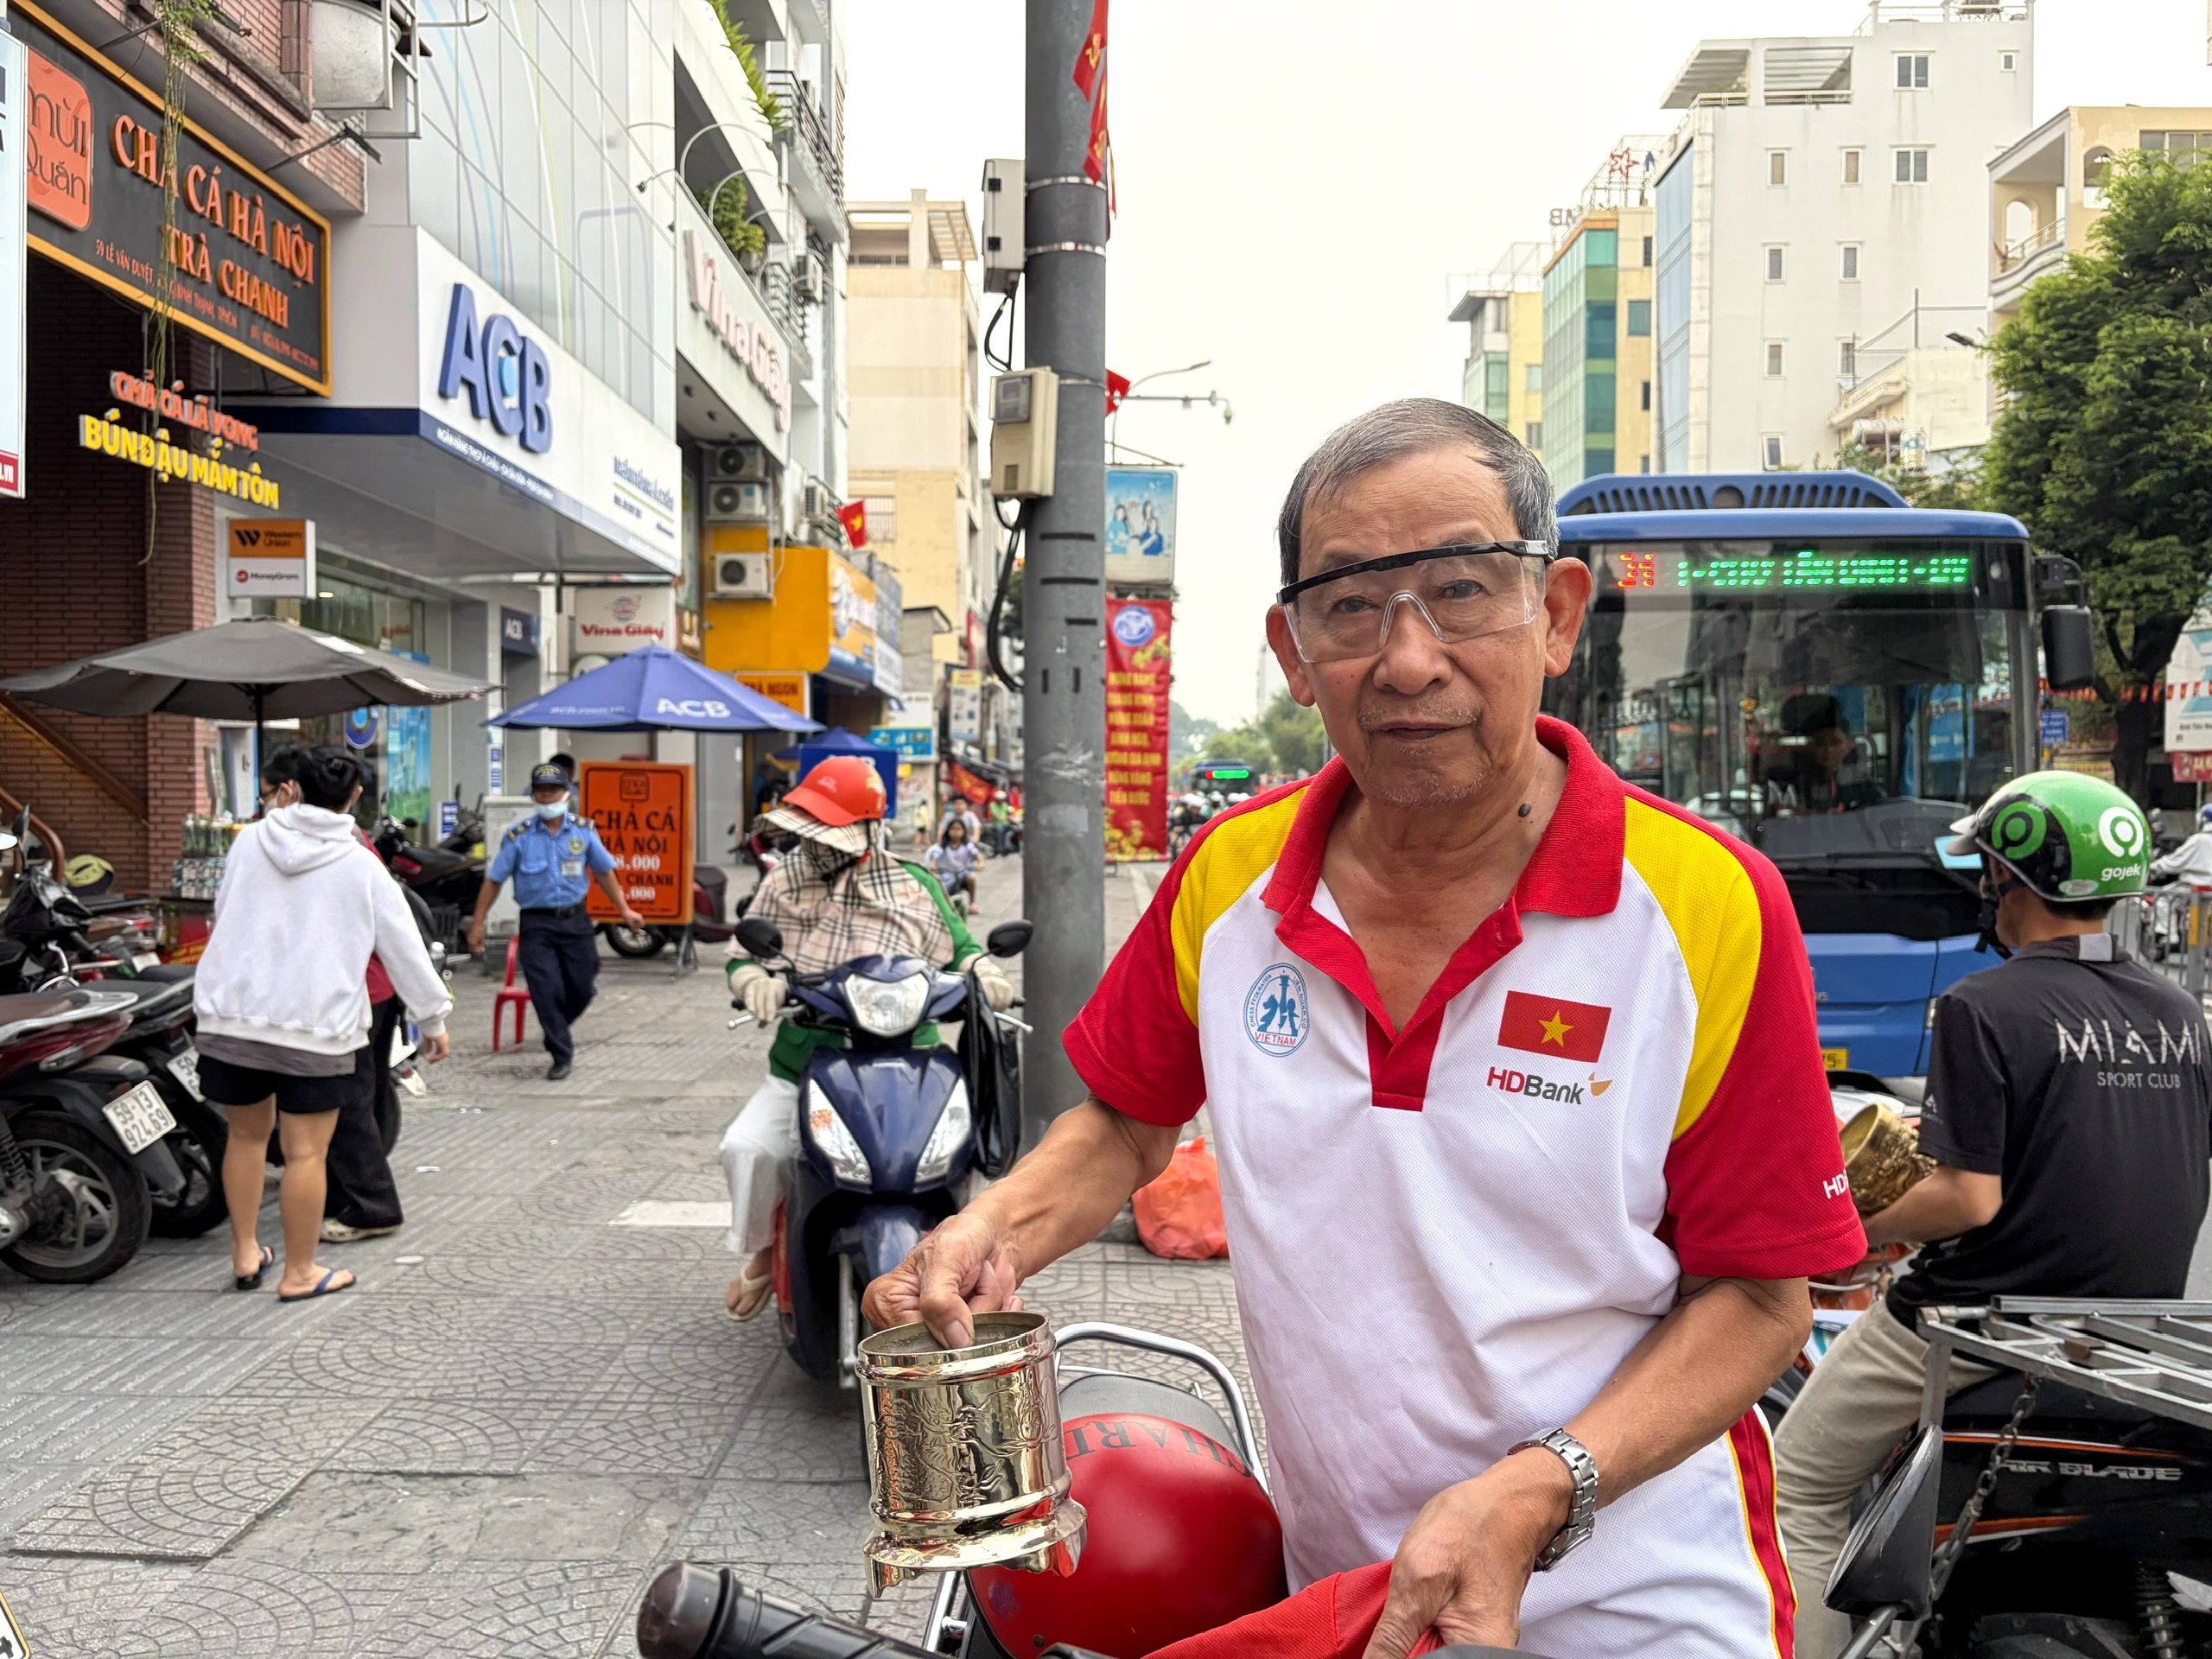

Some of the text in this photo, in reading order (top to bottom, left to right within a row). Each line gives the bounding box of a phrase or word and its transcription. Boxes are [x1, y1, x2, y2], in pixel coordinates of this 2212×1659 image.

[183, 164, 225, 227] CÁ
[228, 190, 269, 257] HÀ
[273, 220, 315, 289] NỘI
[162, 225, 289, 329] TRÀ CHANH
[438, 283, 554, 454] ACB
[111, 368, 157, 411] CHẢ
[160, 378, 185, 423] CÁ
[211, 408, 258, 453] VỌNG
[79, 407, 280, 511] BÚN ĐẬU MẮM TÔM
[264, 538, 291, 549] Union
[581, 623, 622, 637] Vina
[657, 697, 731, 719] ACB
[591, 804, 676, 832] CHẢ CÁ
[633, 835, 668, 855] NỘI
[611, 854, 660, 871] 8.000
[2101, 863, 2141, 882] gojek
[626, 873, 675, 886] CHANH
[1255, 1032, 1296, 1046] VIETNAM
[2055, 1018, 2201, 1065] MIAMI
[1486, 1066, 1585, 1105] HDBank
[2097, 1071, 2182, 1090] SPORT CLUB
[2058, 1462, 2183, 1481] BLADE
